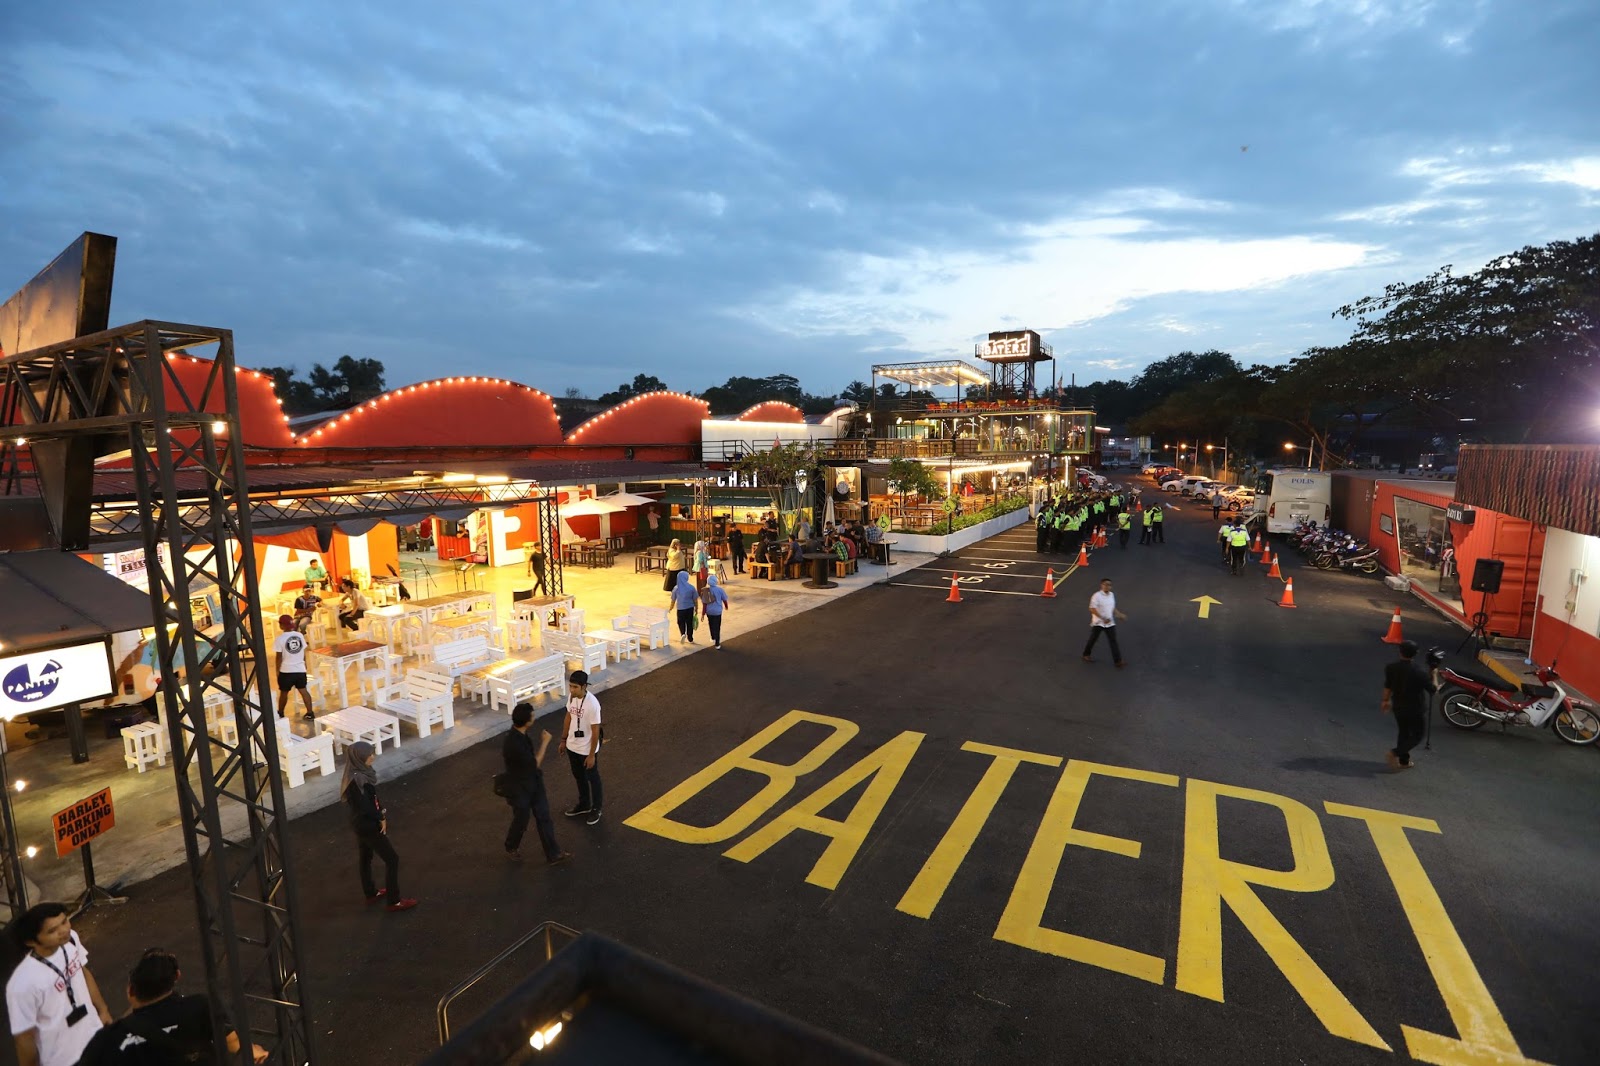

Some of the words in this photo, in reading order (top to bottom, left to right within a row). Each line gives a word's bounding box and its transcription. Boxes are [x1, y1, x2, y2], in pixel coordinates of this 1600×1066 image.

[984, 342, 1027, 355] BATERI
[7, 669, 59, 694] PANTRY
[58, 792, 107, 826] HARLEY
[58, 803, 112, 842] PARKING
[71, 820, 101, 847] ONLY
[622, 709, 1558, 1066] BATERI
